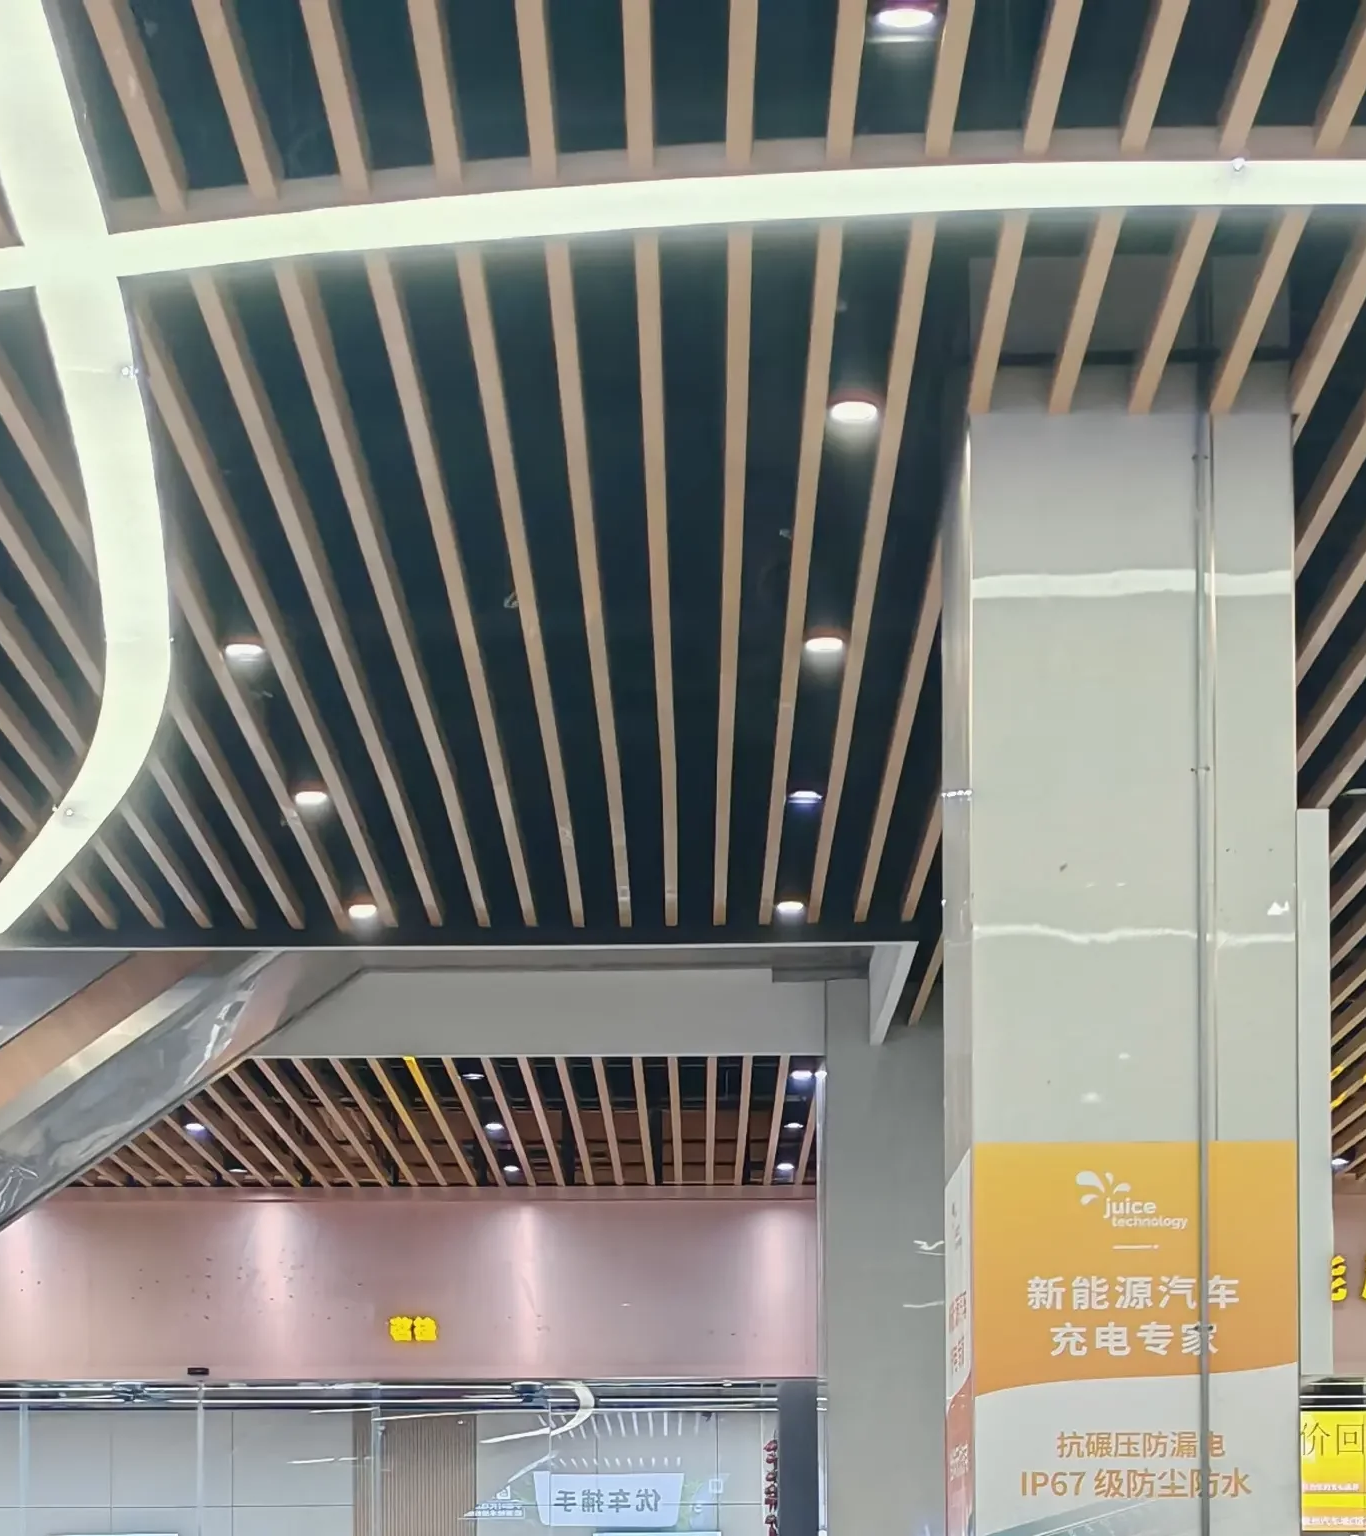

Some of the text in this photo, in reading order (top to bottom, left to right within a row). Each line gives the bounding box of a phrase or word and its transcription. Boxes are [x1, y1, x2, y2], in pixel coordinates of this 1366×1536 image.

[1103, 1197, 1157, 1219] juice
[1112, 1216, 1188, 1230] technology
[1027, 1275, 1240, 1311] 新能源汽车
[1050, 1321, 1219, 1357] 充电专家
[1056, 1431, 1227, 1459] 抗碾压防漏电
[1020, 1467, 1253, 1499] IP67 级防尘防水
